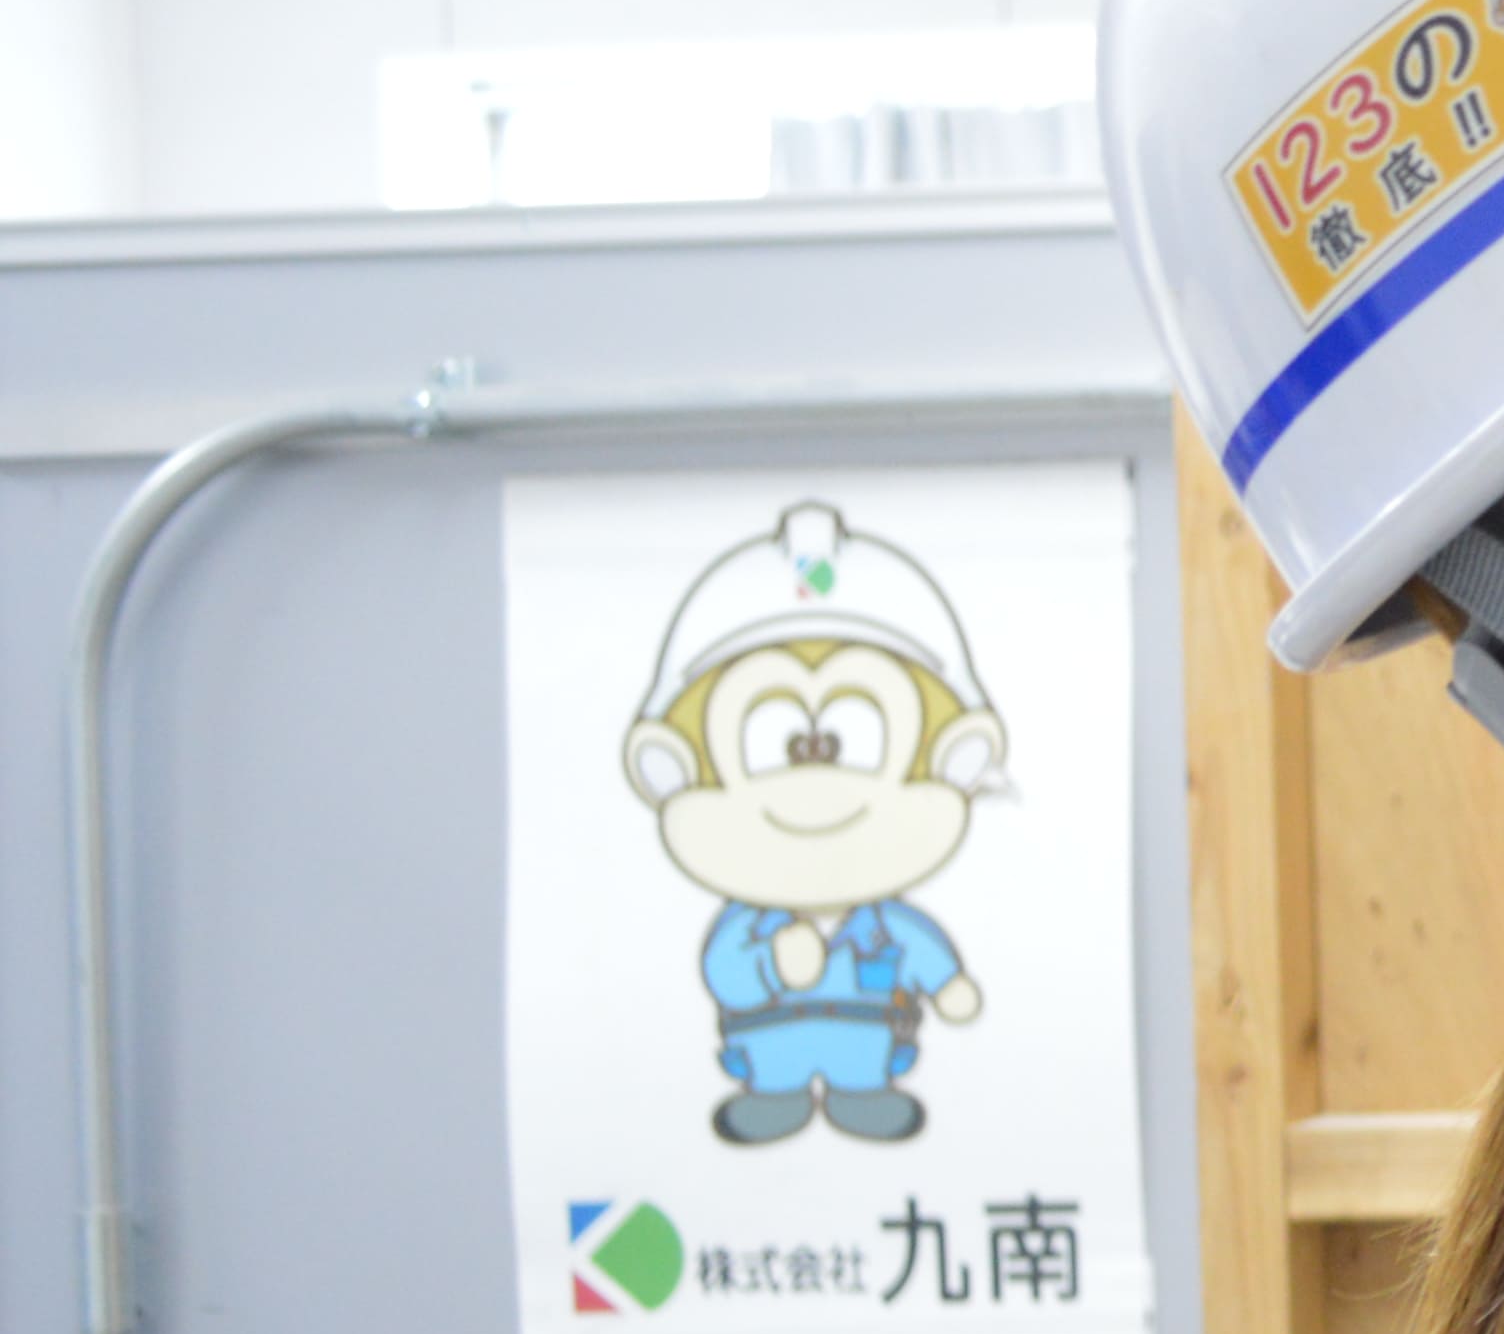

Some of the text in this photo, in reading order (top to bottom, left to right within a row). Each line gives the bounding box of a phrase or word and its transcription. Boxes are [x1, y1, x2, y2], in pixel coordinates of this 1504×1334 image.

[1254, 14, 1472, 230] 123の
[697, 1194, 1082, 1305] 株式会社九南
